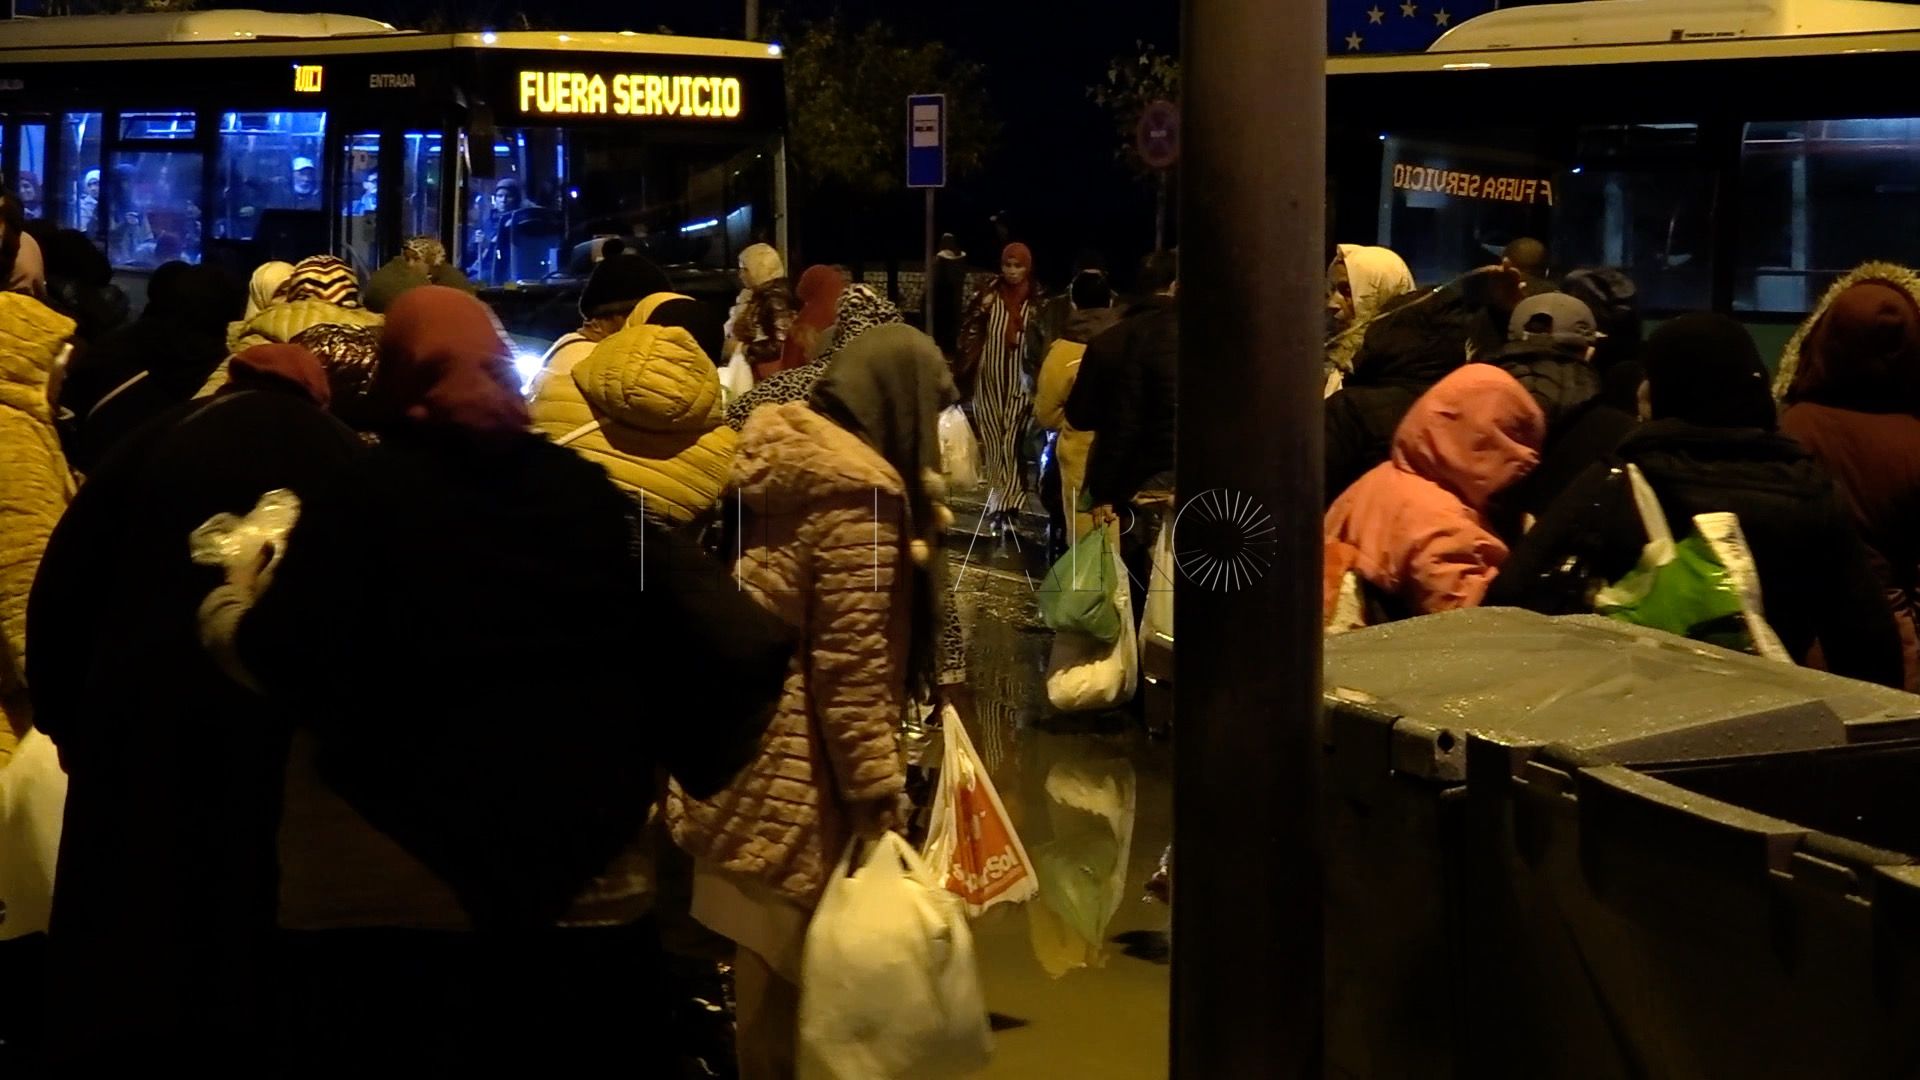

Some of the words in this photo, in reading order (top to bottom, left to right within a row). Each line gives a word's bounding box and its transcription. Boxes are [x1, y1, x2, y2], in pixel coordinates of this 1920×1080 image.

[369, 73, 416, 88] ENTRADA
[519, 71, 608, 114] FUERA
[612, 74, 740, 117] SERVICIO
